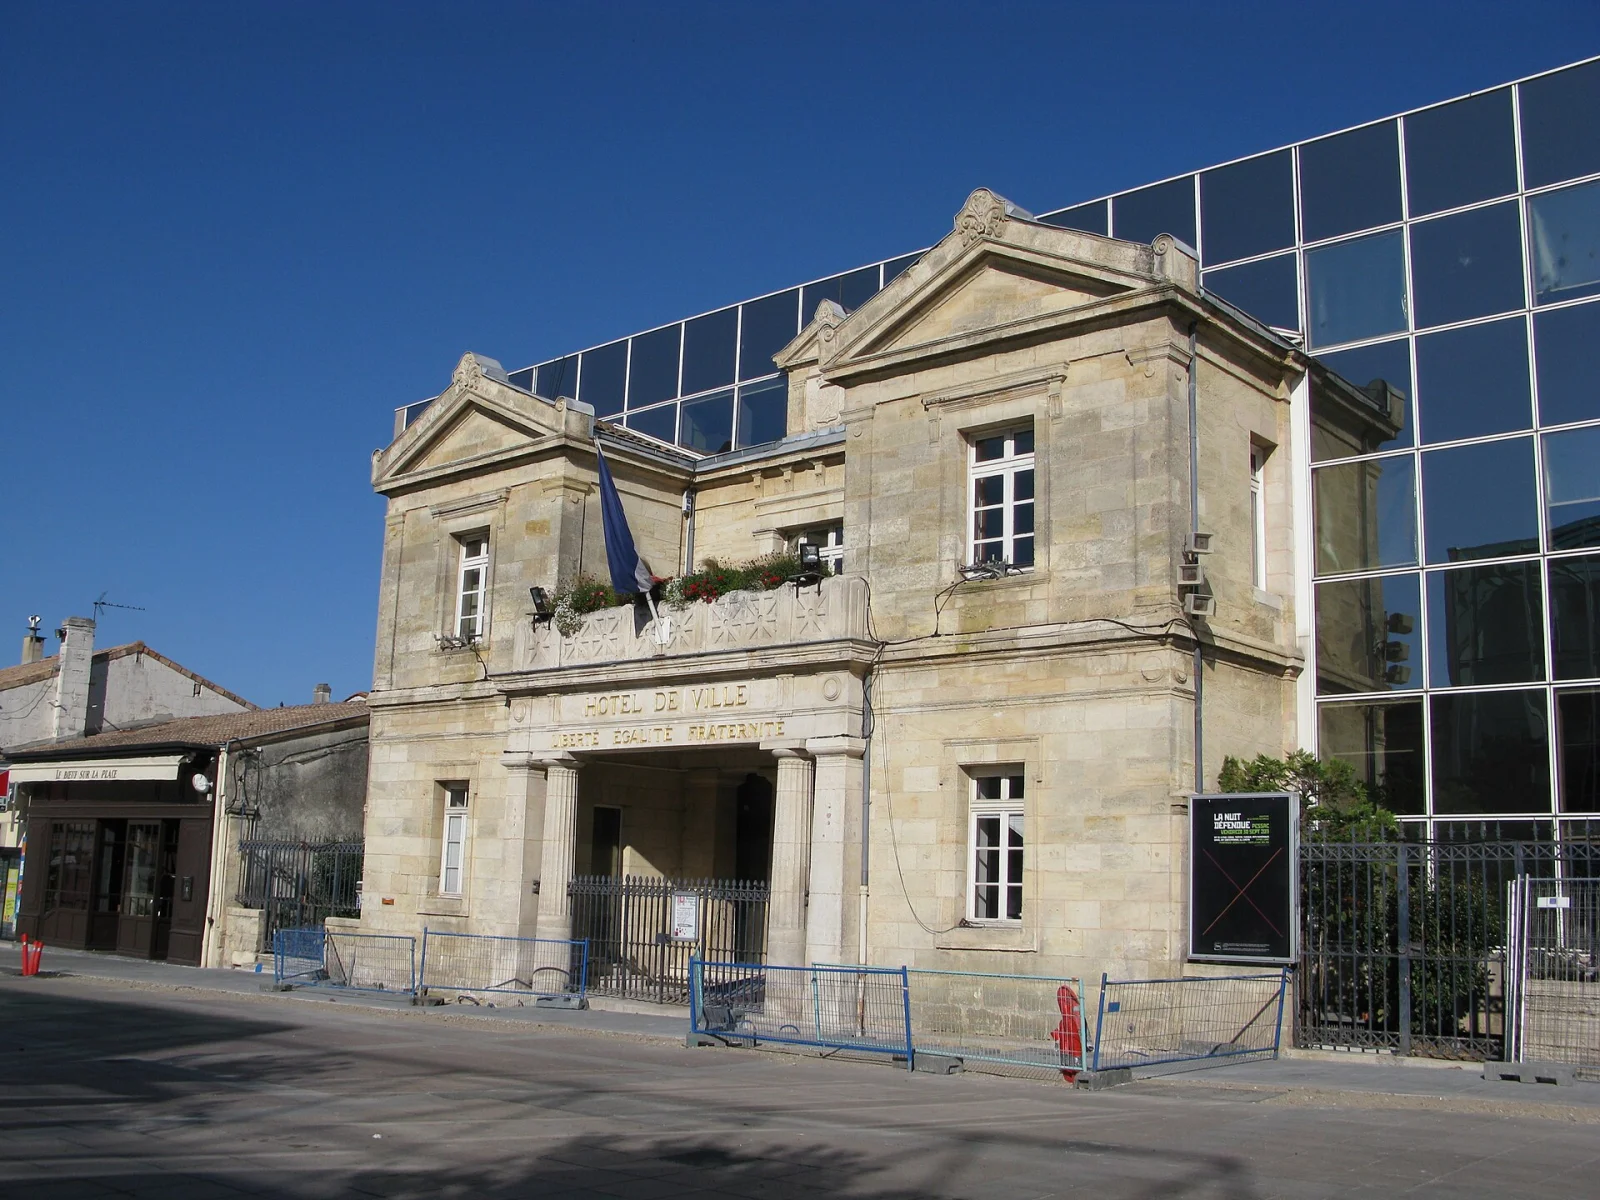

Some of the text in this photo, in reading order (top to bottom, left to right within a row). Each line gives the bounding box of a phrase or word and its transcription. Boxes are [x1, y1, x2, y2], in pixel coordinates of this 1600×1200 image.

[584, 684, 748, 717] HOTEL DE VILLE
[551, 720, 785, 749] LIBERTÉ ÉGALITÉ FRATERNITÉ
[79, 770, 91, 779] SUR
[91, 770, 99, 779] LA
[101, 770, 117, 778] PLACE
[1214, 813, 1223, 821] LA
[1224, 813, 1241, 821] NUIT
[1214, 820, 1250, 829] DÉFENDUE
